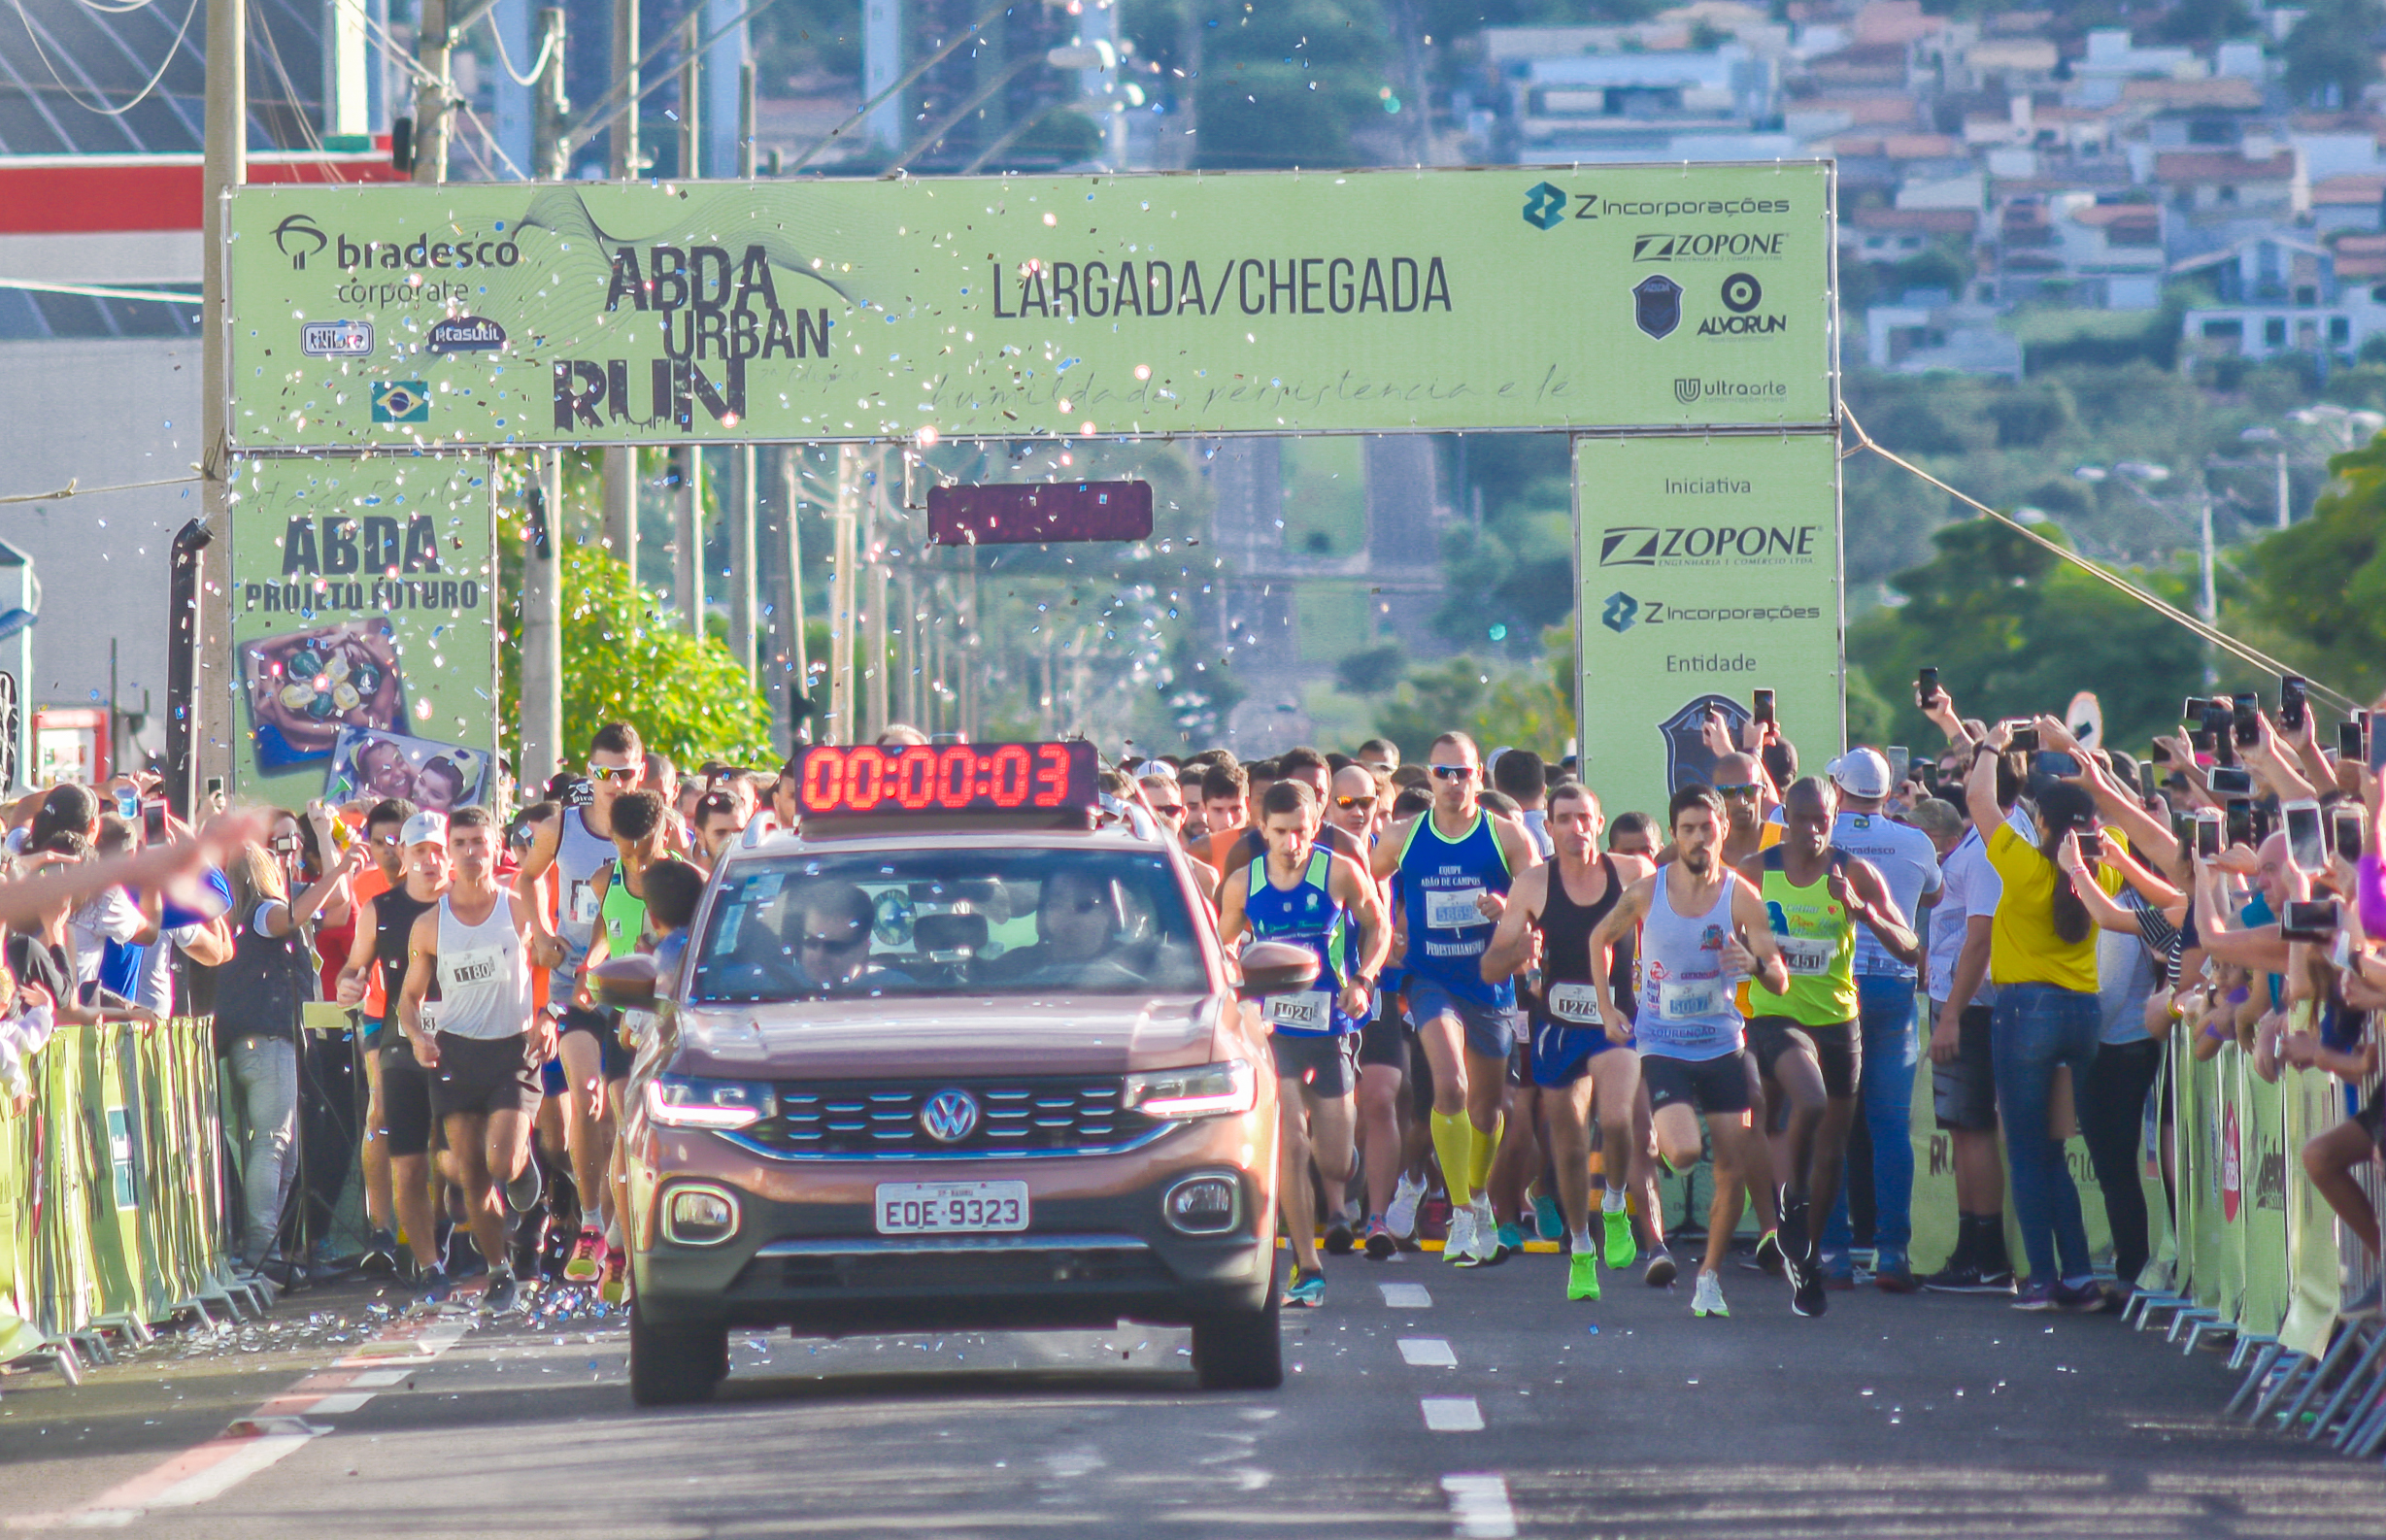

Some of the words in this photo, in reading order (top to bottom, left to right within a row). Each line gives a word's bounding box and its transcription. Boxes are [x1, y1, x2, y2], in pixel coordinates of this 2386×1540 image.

[1574, 194, 1598, 219] Z
[1602, 197, 1790, 218] Incorporações
[337, 232, 520, 270] bradesco
[1675, 233, 1786, 256] ZOPONE
[604, 244, 779, 312] ABDA
[991, 256, 1454, 318] LARGADA/CHEGADA
[338, 280, 469, 310] corporate
[661, 307, 830, 360] URBAN
[1696, 314, 1787, 336] ALVORUN
[553, 358, 747, 434] RUN
[1704, 380, 1787, 396] ultraarte
[1665, 478, 1752, 494] Iniciativa
[282, 515, 441, 576] ABDA
[1660, 525, 1817, 558] ZOPONE
[1658, 558, 1721, 567] ENGENHARIA
[245, 581, 364, 613] PROJETO
[371, 580, 479, 611] FUTURO
[1644, 601, 1663, 623] Z
[1666, 604, 1820, 622] Incorporações
[1665, 653, 1757, 673] Entidade
[1682, 711, 1738, 731] AA
[802, 744, 1070, 812] 00:00:03
[1441, 877, 1452, 887] DE
[1452, 876, 1481, 887] CAMPOS
[455, 963, 491, 982] 1180
[1276, 1003, 1313, 1021] 1024
[1561, 999, 1597, 1016] 1275
[1669, 997, 1709, 1014] 5097
